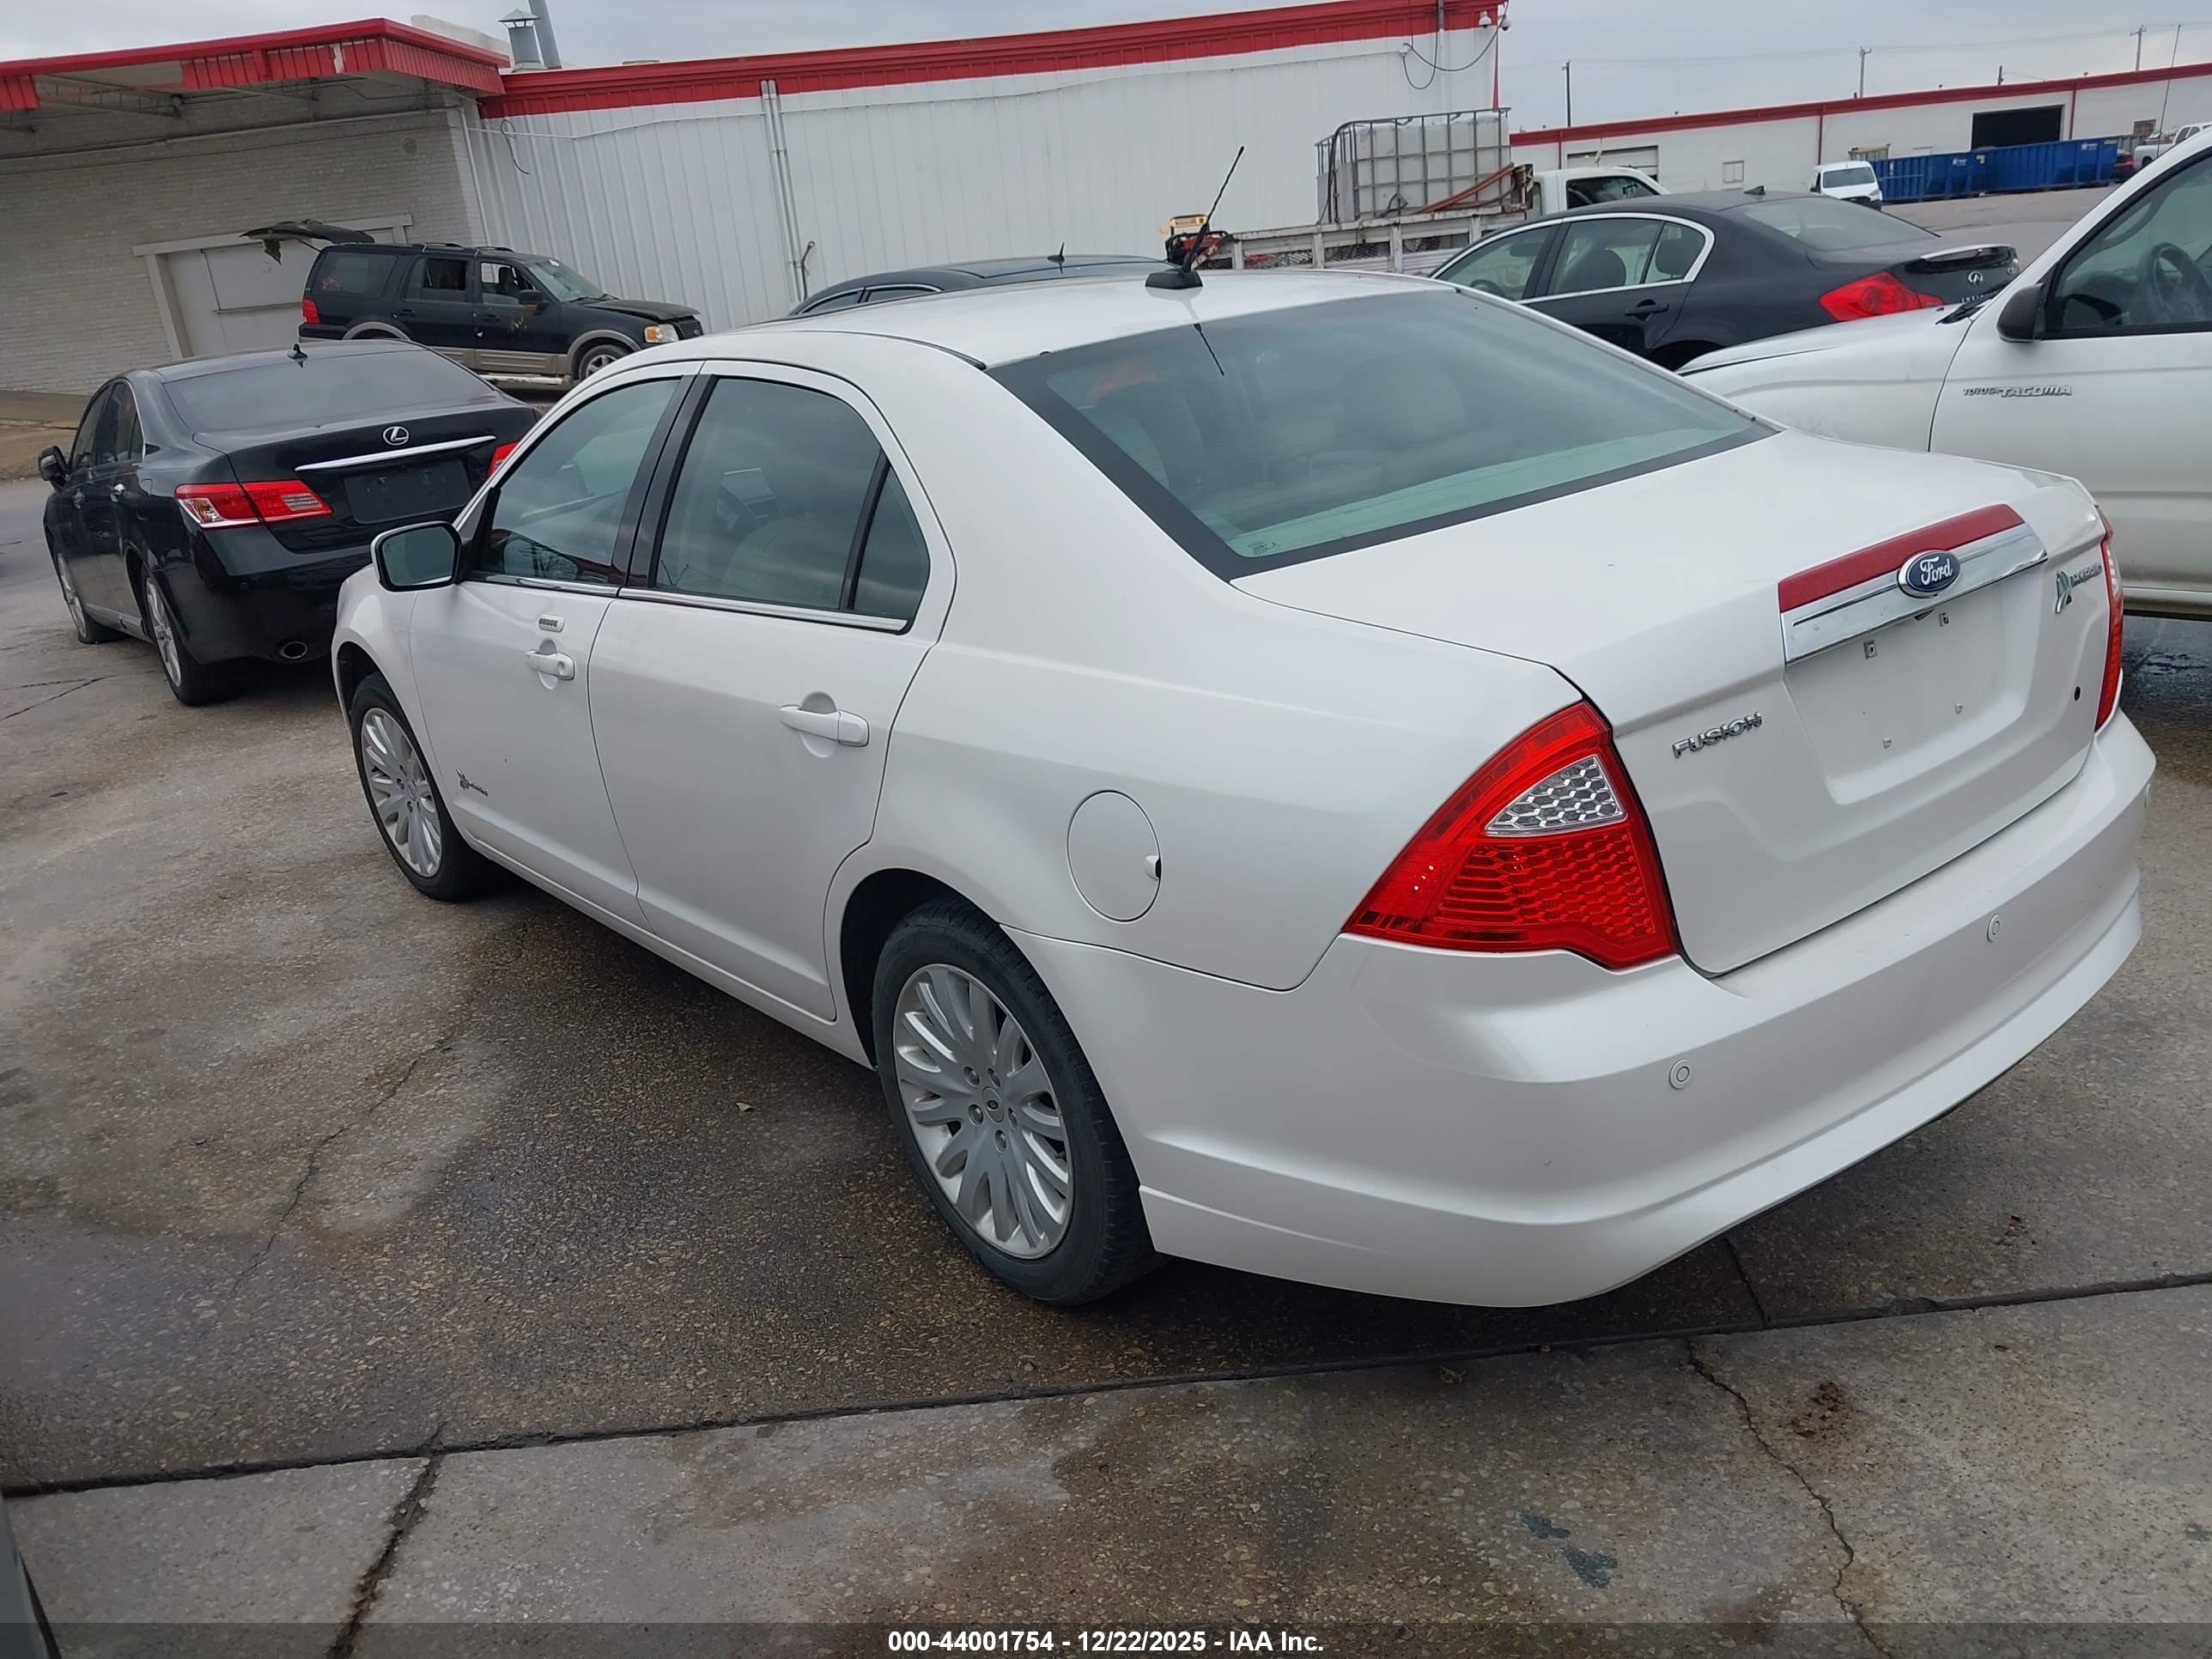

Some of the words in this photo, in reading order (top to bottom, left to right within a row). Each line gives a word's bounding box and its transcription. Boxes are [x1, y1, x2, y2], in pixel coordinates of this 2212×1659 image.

[2000, 386, 2073, 398] TACOMA
[1919, 556, 1954, 586] Ford
[1672, 711, 1763, 759] FUSION
